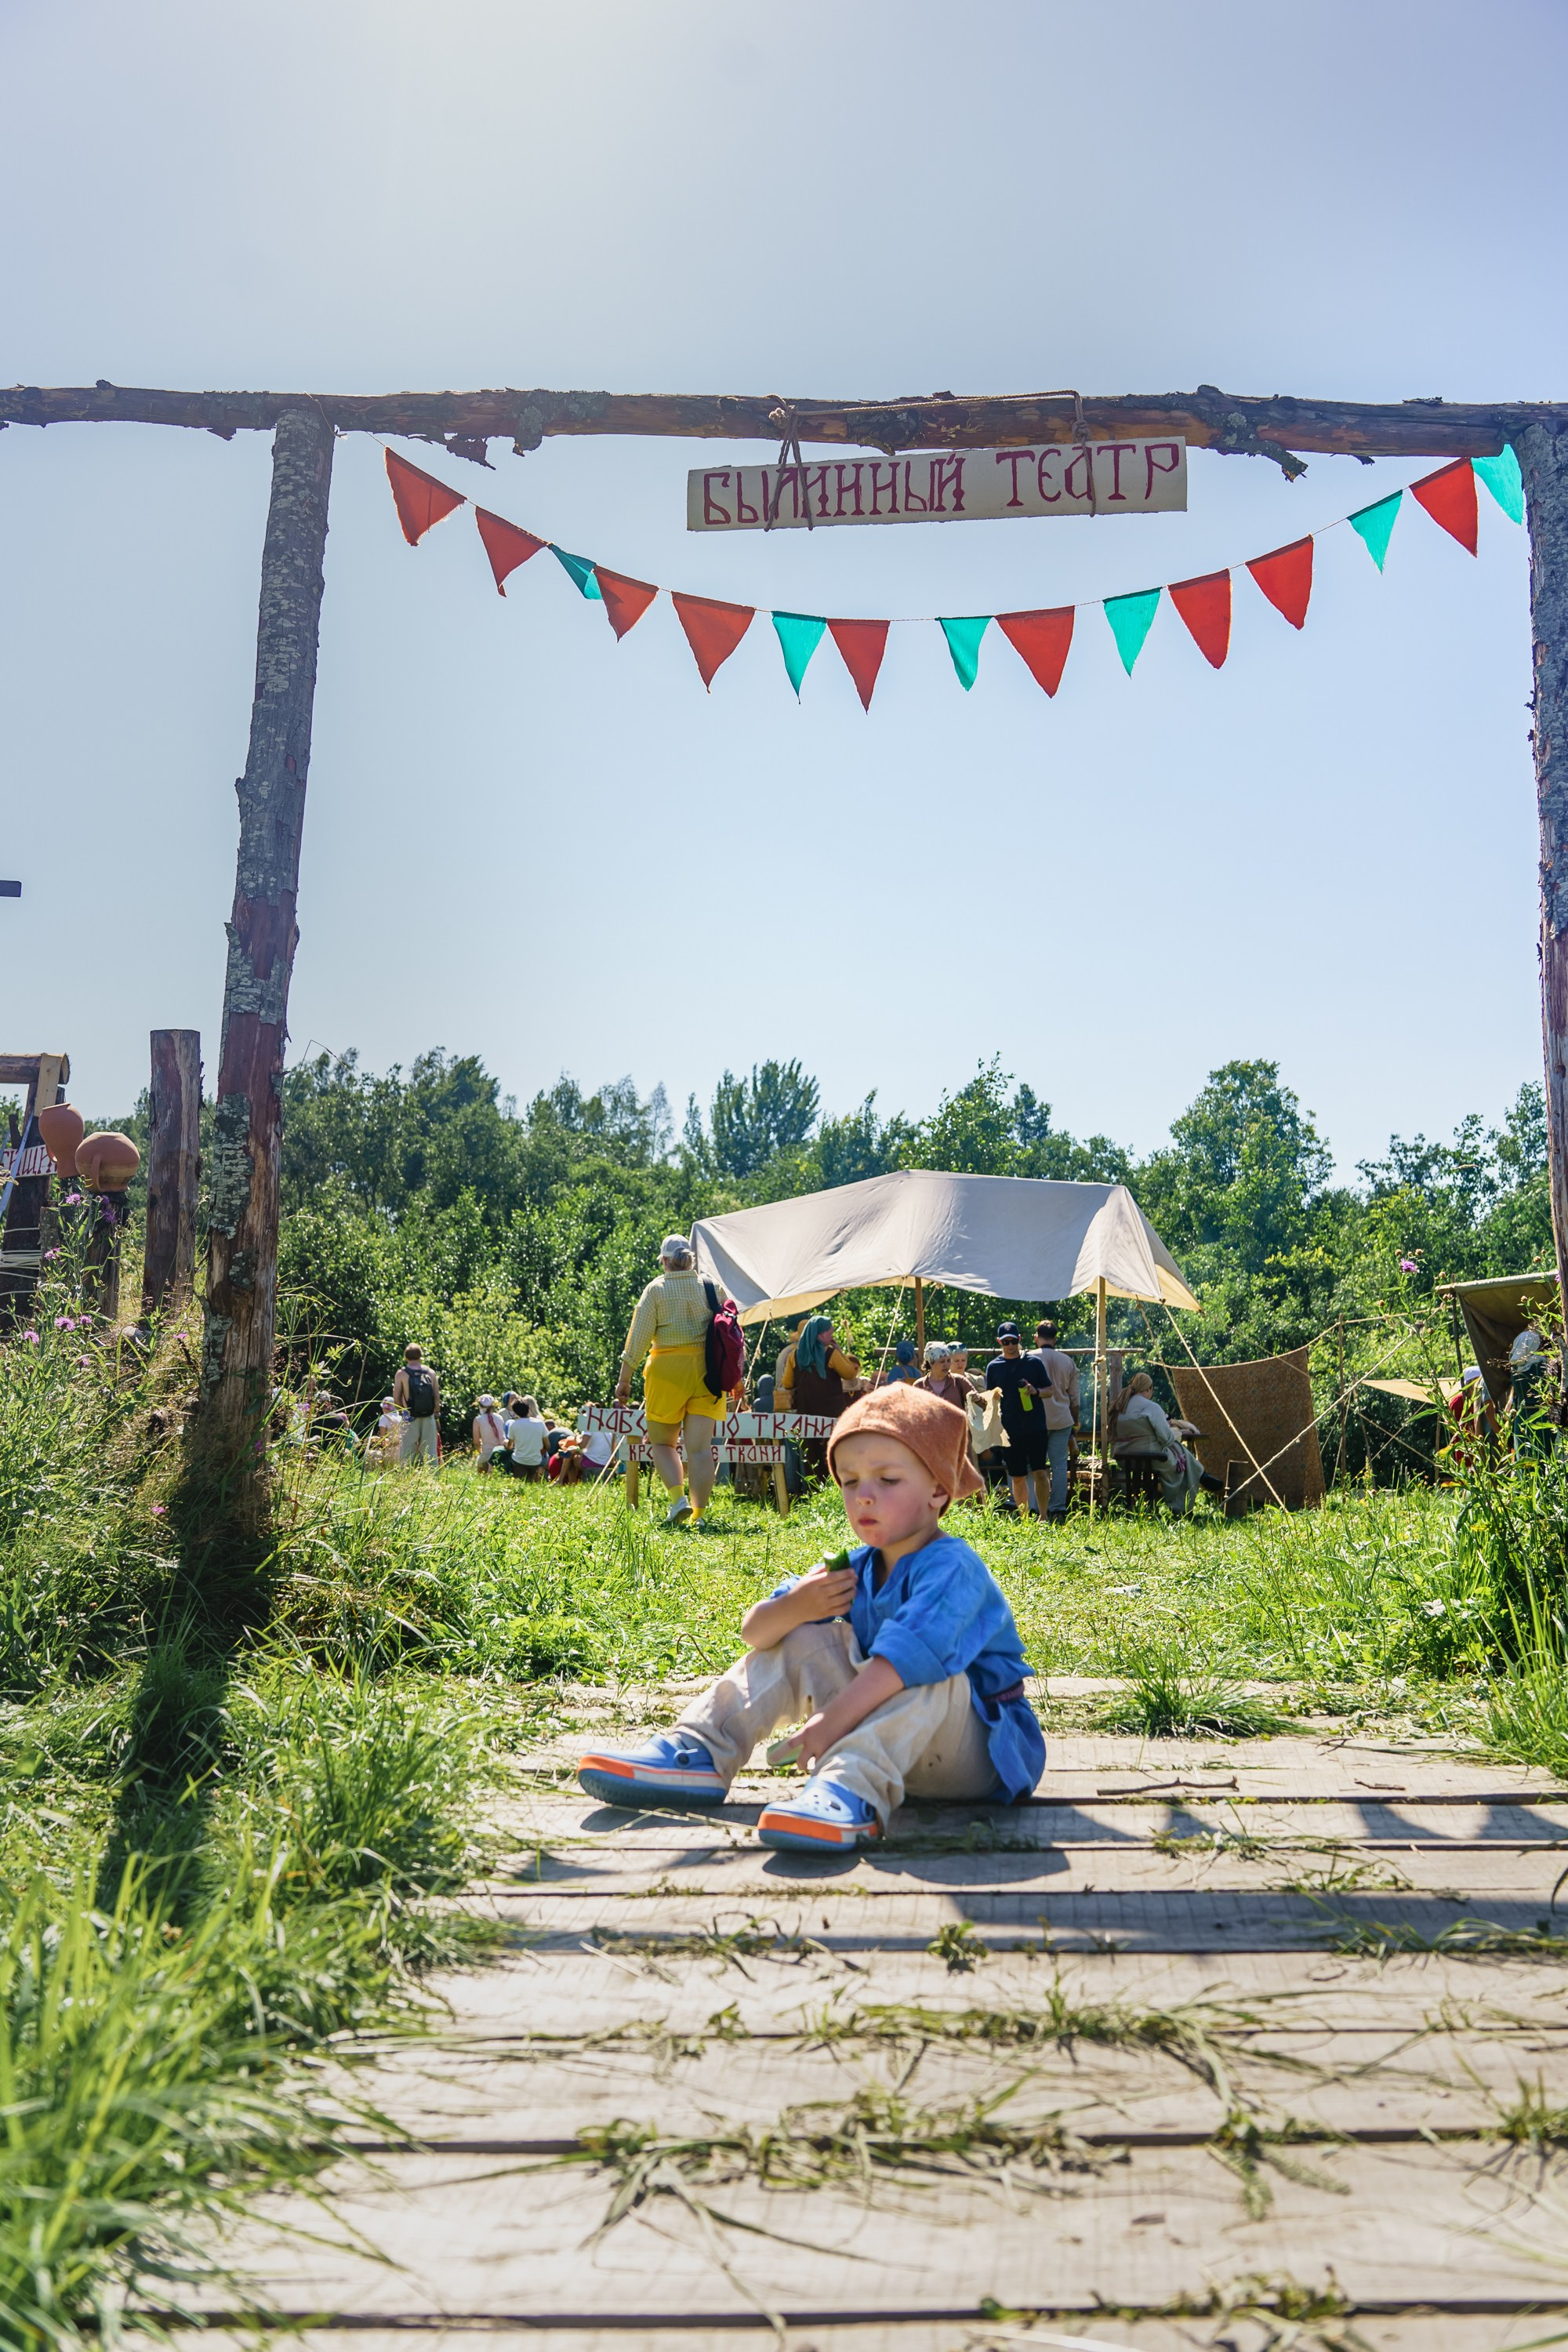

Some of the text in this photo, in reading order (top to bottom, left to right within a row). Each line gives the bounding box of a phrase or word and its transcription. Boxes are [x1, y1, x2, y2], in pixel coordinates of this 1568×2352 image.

[704, 444, 1179, 524] БЫЛИННЫЙ ТЕАТР
[752, 1414, 834, 1438] ТКАНИ
[726, 1446, 781, 1461] ТКАНИ
